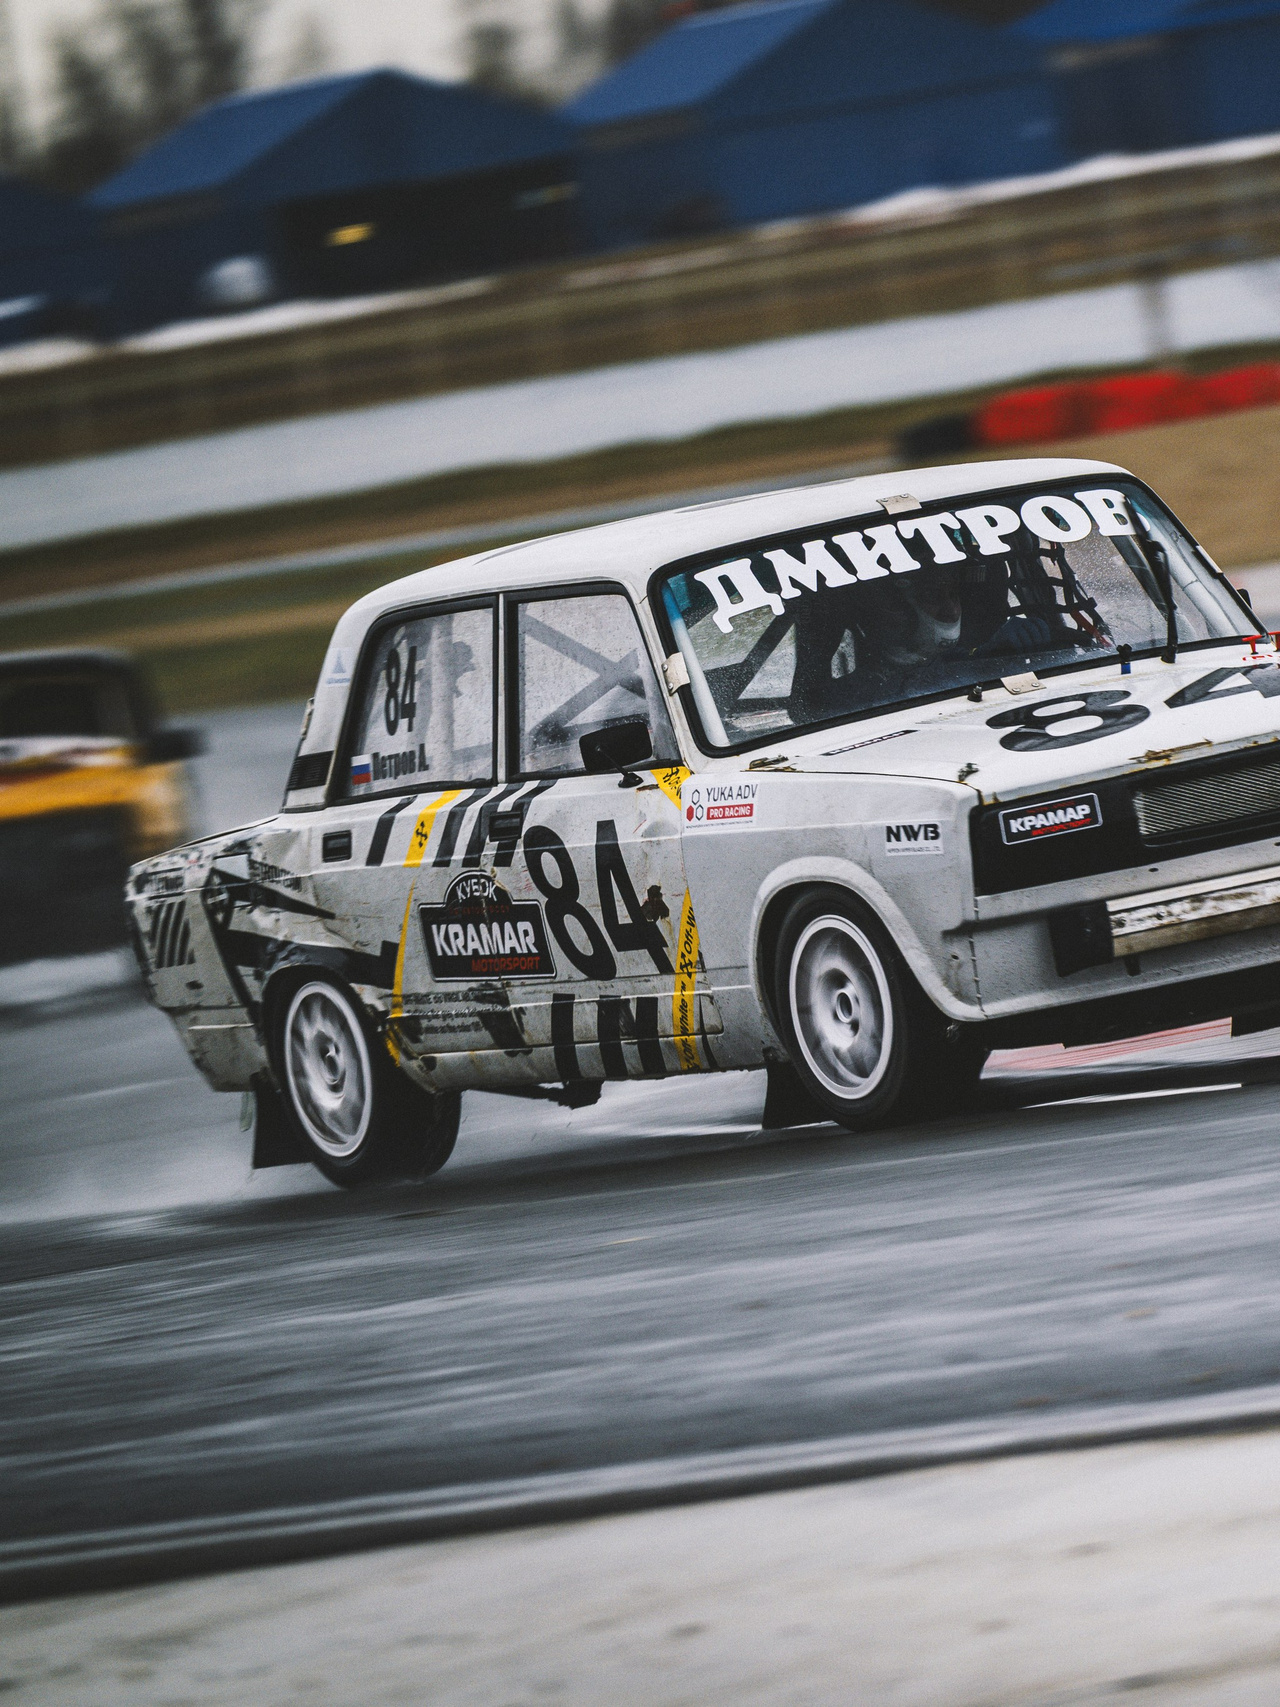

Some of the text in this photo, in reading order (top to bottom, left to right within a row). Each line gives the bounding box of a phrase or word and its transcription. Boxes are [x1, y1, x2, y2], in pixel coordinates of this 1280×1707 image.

[694, 489, 1150, 634] ДМИТРОВ
[384, 645, 418, 737] 84
[706, 784, 759, 803] YUKA ADV
[709, 806, 751, 819] PRO RACING
[1009, 804, 1092, 833] КРАМАР
[886, 823, 941, 843] NWB
[455, 878, 498, 902] КУБОК
[523, 819, 676, 981] 84
[431, 921, 539, 957] KRAMAR
[471, 956, 541, 972] MOTORSPORT
